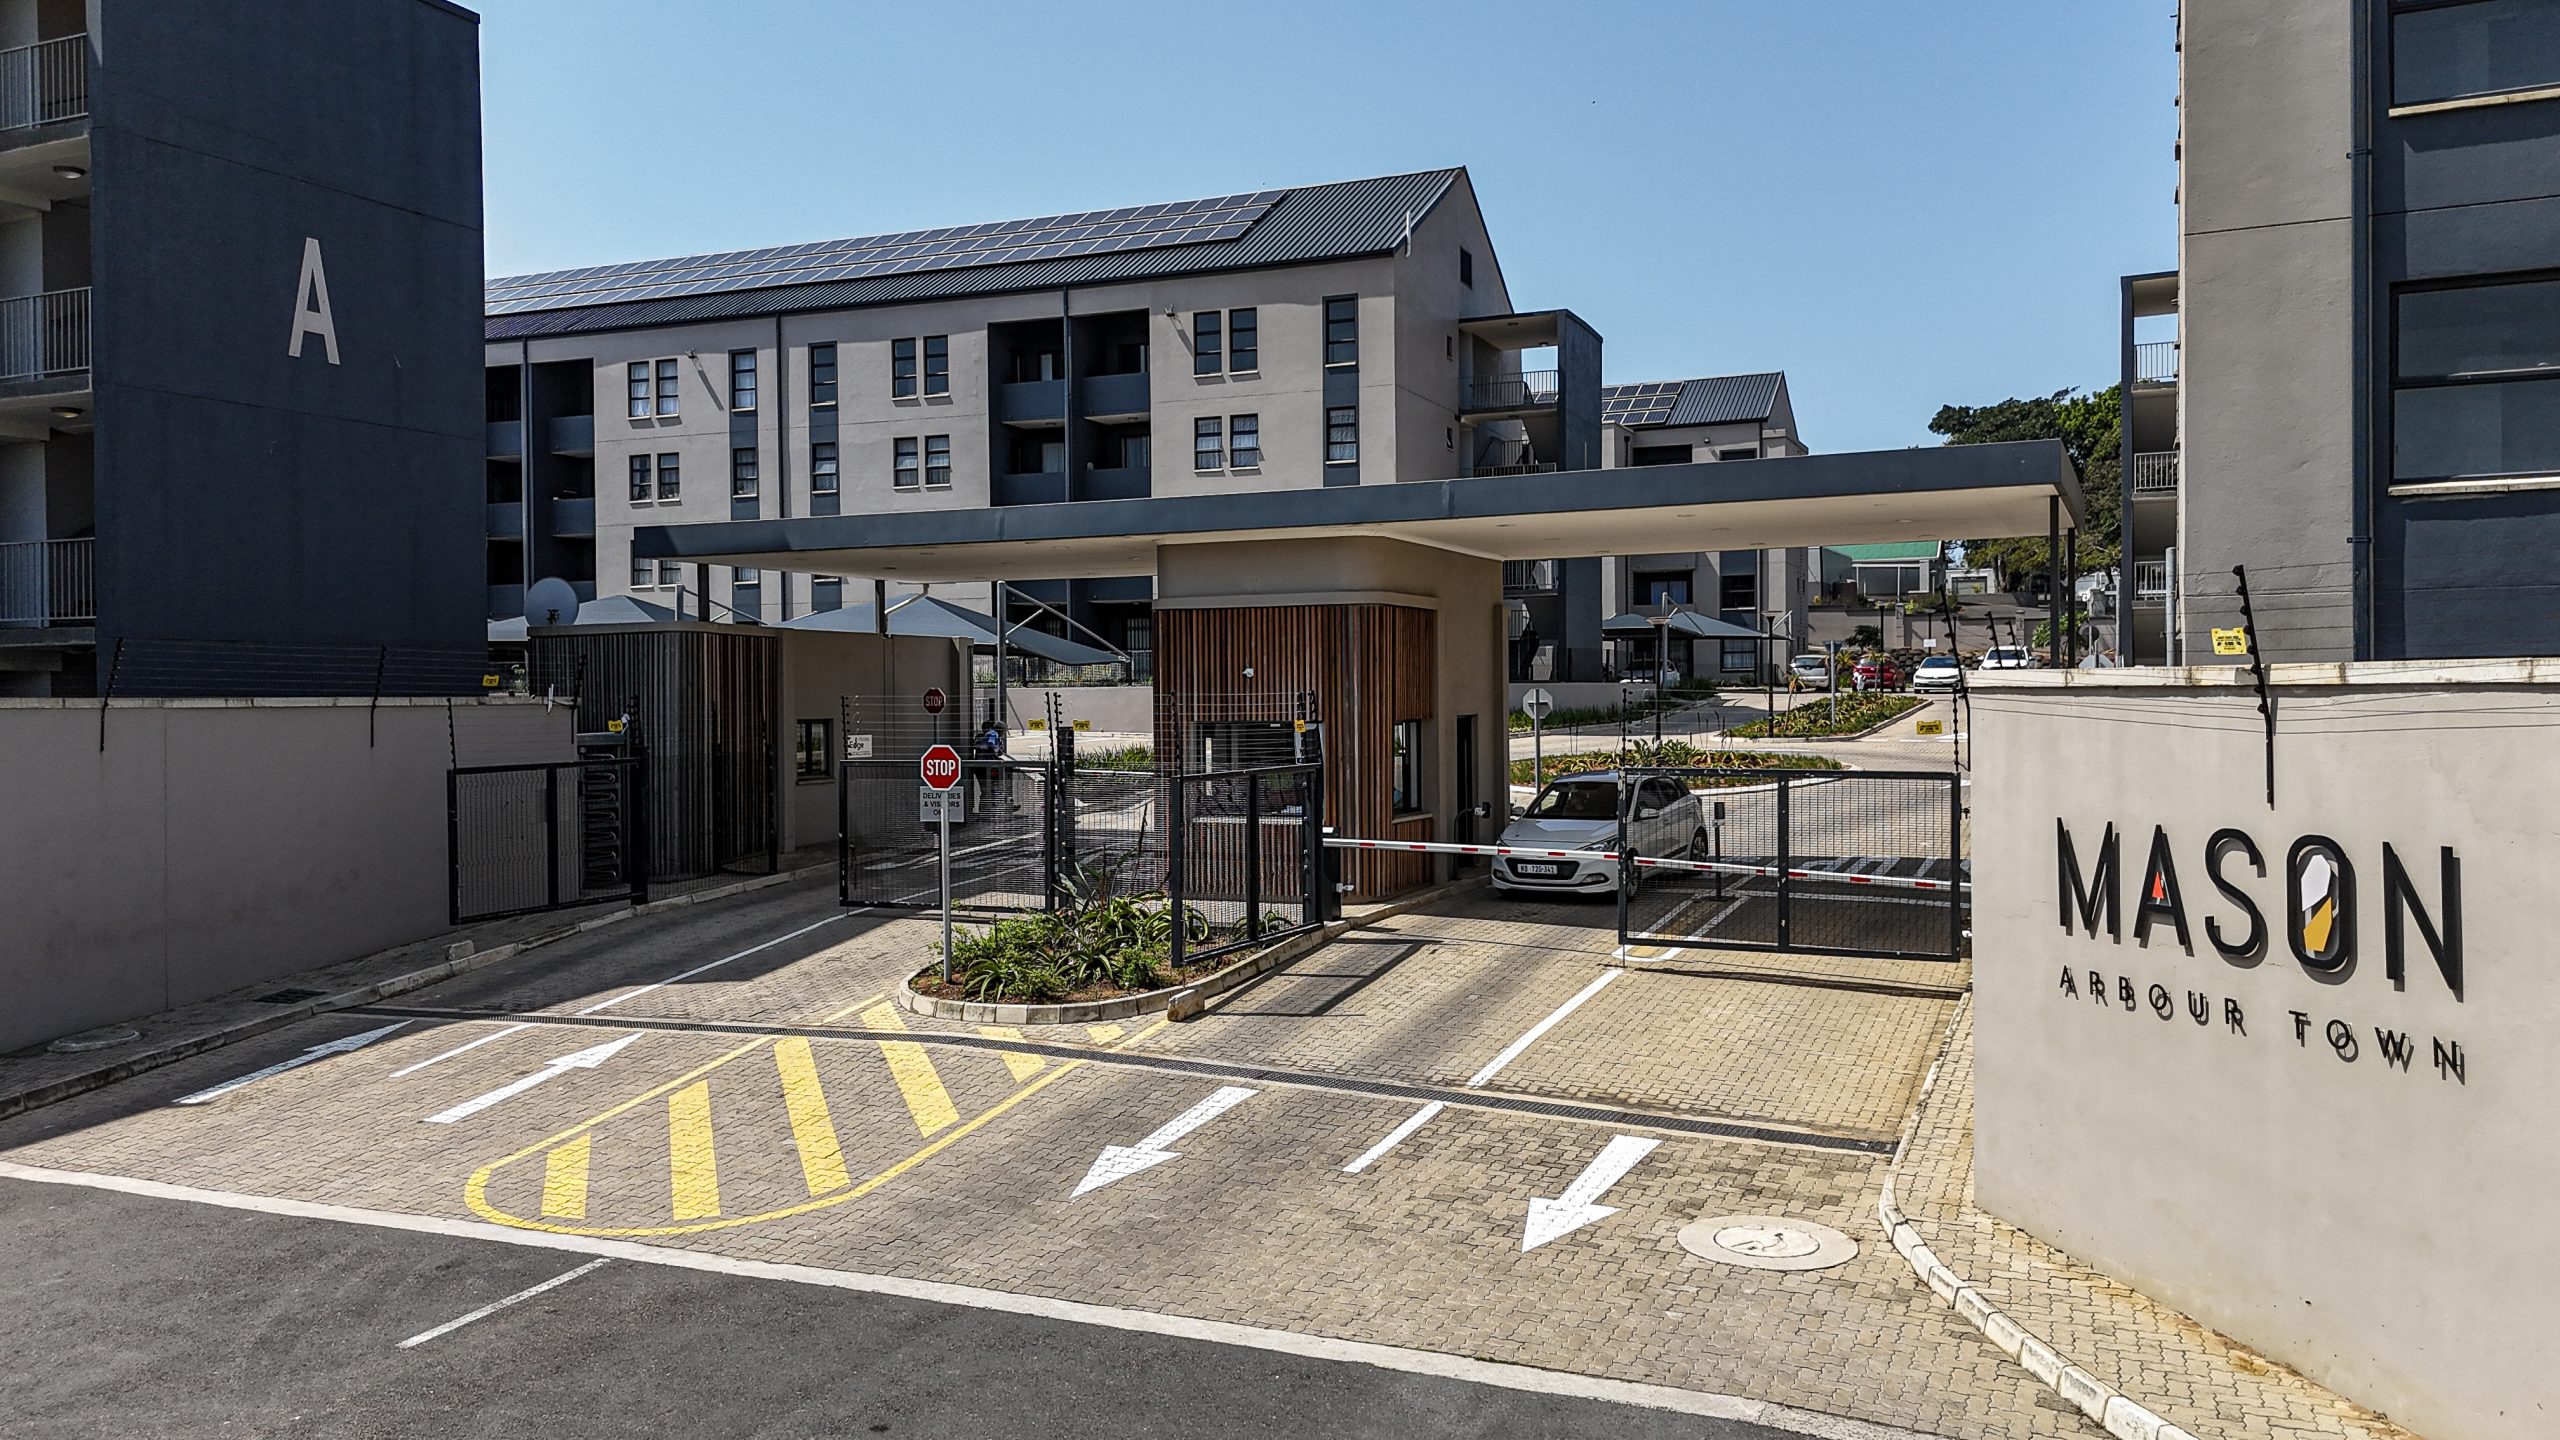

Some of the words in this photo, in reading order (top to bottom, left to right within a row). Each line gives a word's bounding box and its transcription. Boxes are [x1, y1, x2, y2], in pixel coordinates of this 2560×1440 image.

[288, 237, 341, 365] A
[925, 695, 943, 707] STOP
[926, 759, 956, 776] STOP
[922, 792, 961, 800] DELIVIES
[930, 800, 960, 808] VISORS
[2056, 816, 2459, 994] MASON
[2059, 964, 2241, 1028] ARBOUR
[2288, 1009, 2462, 1074] TOWN
